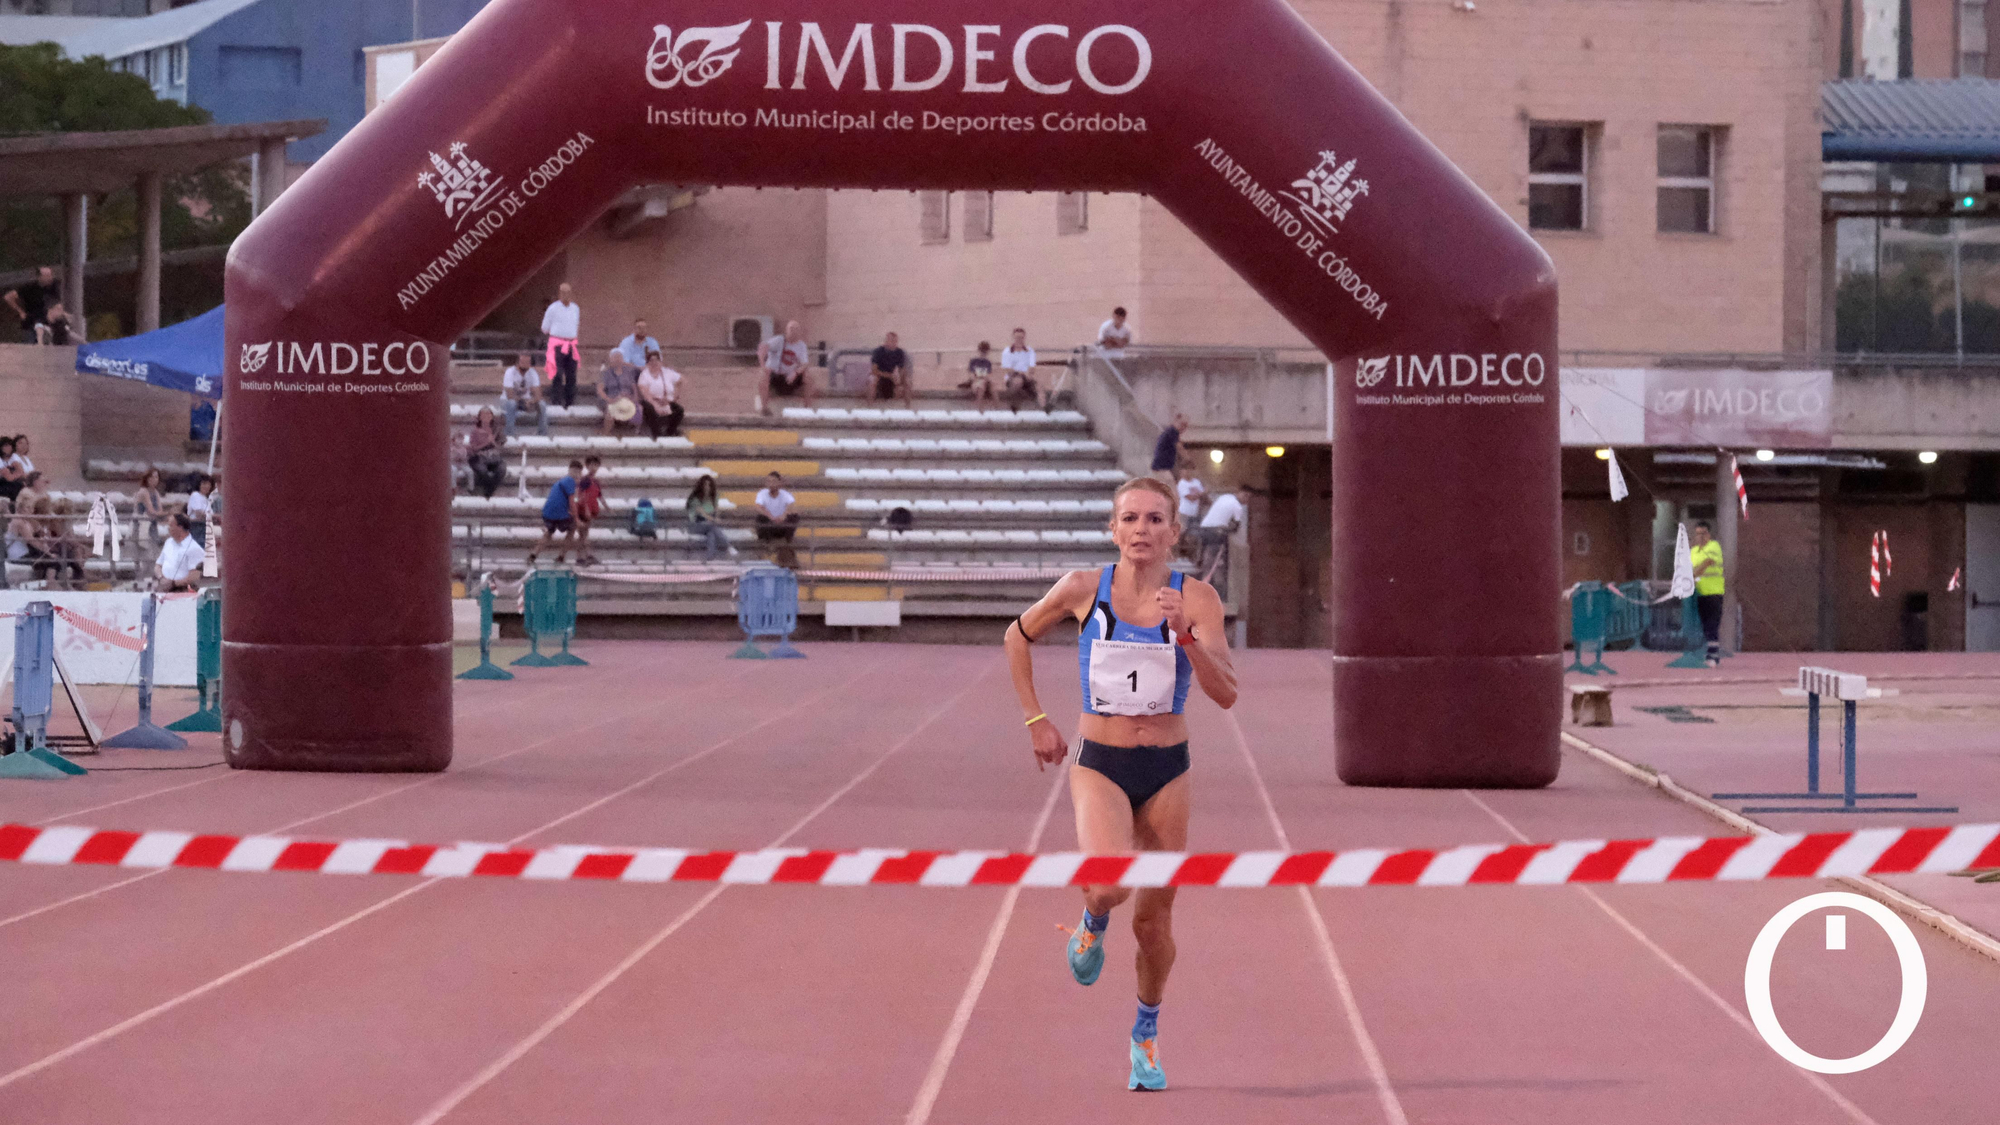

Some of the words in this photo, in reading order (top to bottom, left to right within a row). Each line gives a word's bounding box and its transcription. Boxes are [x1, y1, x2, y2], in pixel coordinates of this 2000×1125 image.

[763, 21, 1152, 95] IMDECO
[646, 106, 747, 128] Instituto
[754, 107, 876, 132] Municipal
[883, 109, 915, 131] de
[922, 110, 1036, 136] Deportes
[1041, 110, 1148, 133] Córdoba
[396, 210, 504, 310] AYUNTAMIENTO
[499, 190, 526, 217] DE
[521, 131, 595, 197] CÓRDOBA
[1193, 138, 1302, 238] AYUNTAMIENTO
[1296, 231, 1324, 258] DE
[1318, 251, 1388, 320] CÓRDOBA
[276, 341, 430, 375] IMDECO
[1395, 352, 1545, 387] IMDECO
[240, 380, 272, 391] Instituto
[273, 380, 324, 393] Municipal
[327, 381, 342, 392] de
[345, 382, 393, 395] Deportes
[395, 381, 430, 393] Córdoba
[1356, 394, 1391, 405] Instituto
[1392, 394, 1444, 406] Municipal
[1447, 393, 1461, 404] de
[1464, 393, 1511, 406] Deportes
[1513, 392, 1545, 404] Córdoba
[1694, 387, 1824, 417] IMDECO
[1126, 670, 1138, 693] 1
